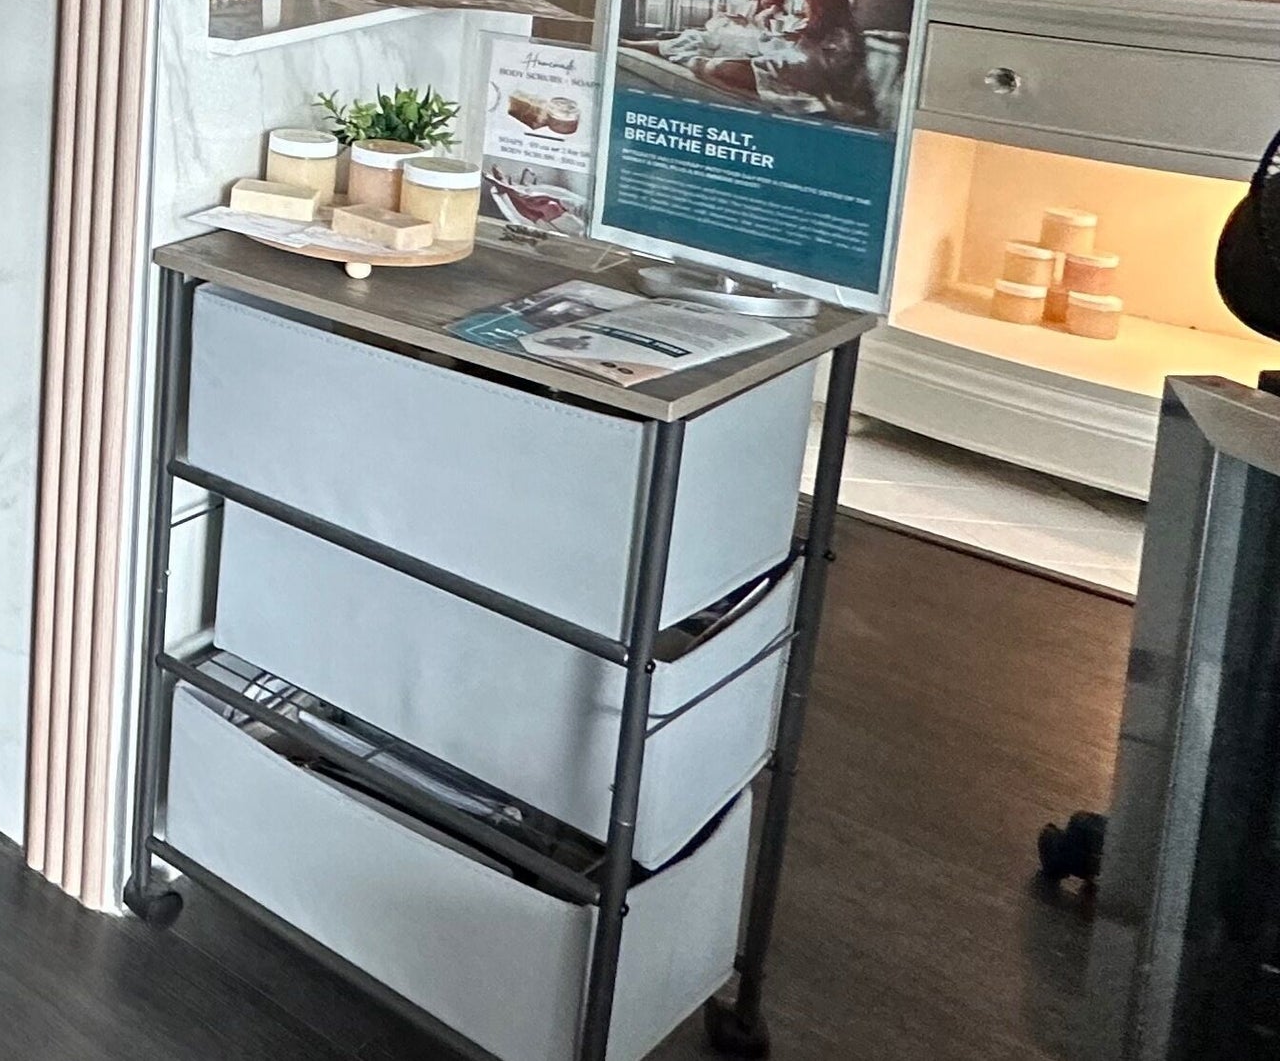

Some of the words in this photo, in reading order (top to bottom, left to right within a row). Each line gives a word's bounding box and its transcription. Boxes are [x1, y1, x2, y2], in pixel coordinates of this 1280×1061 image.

[624, 126, 701, 154] BREATHE
[704, 142, 775, 169] BETTER
[625, 111, 704, 138] BREATHE
[707, 127, 758, 151] SALT,
